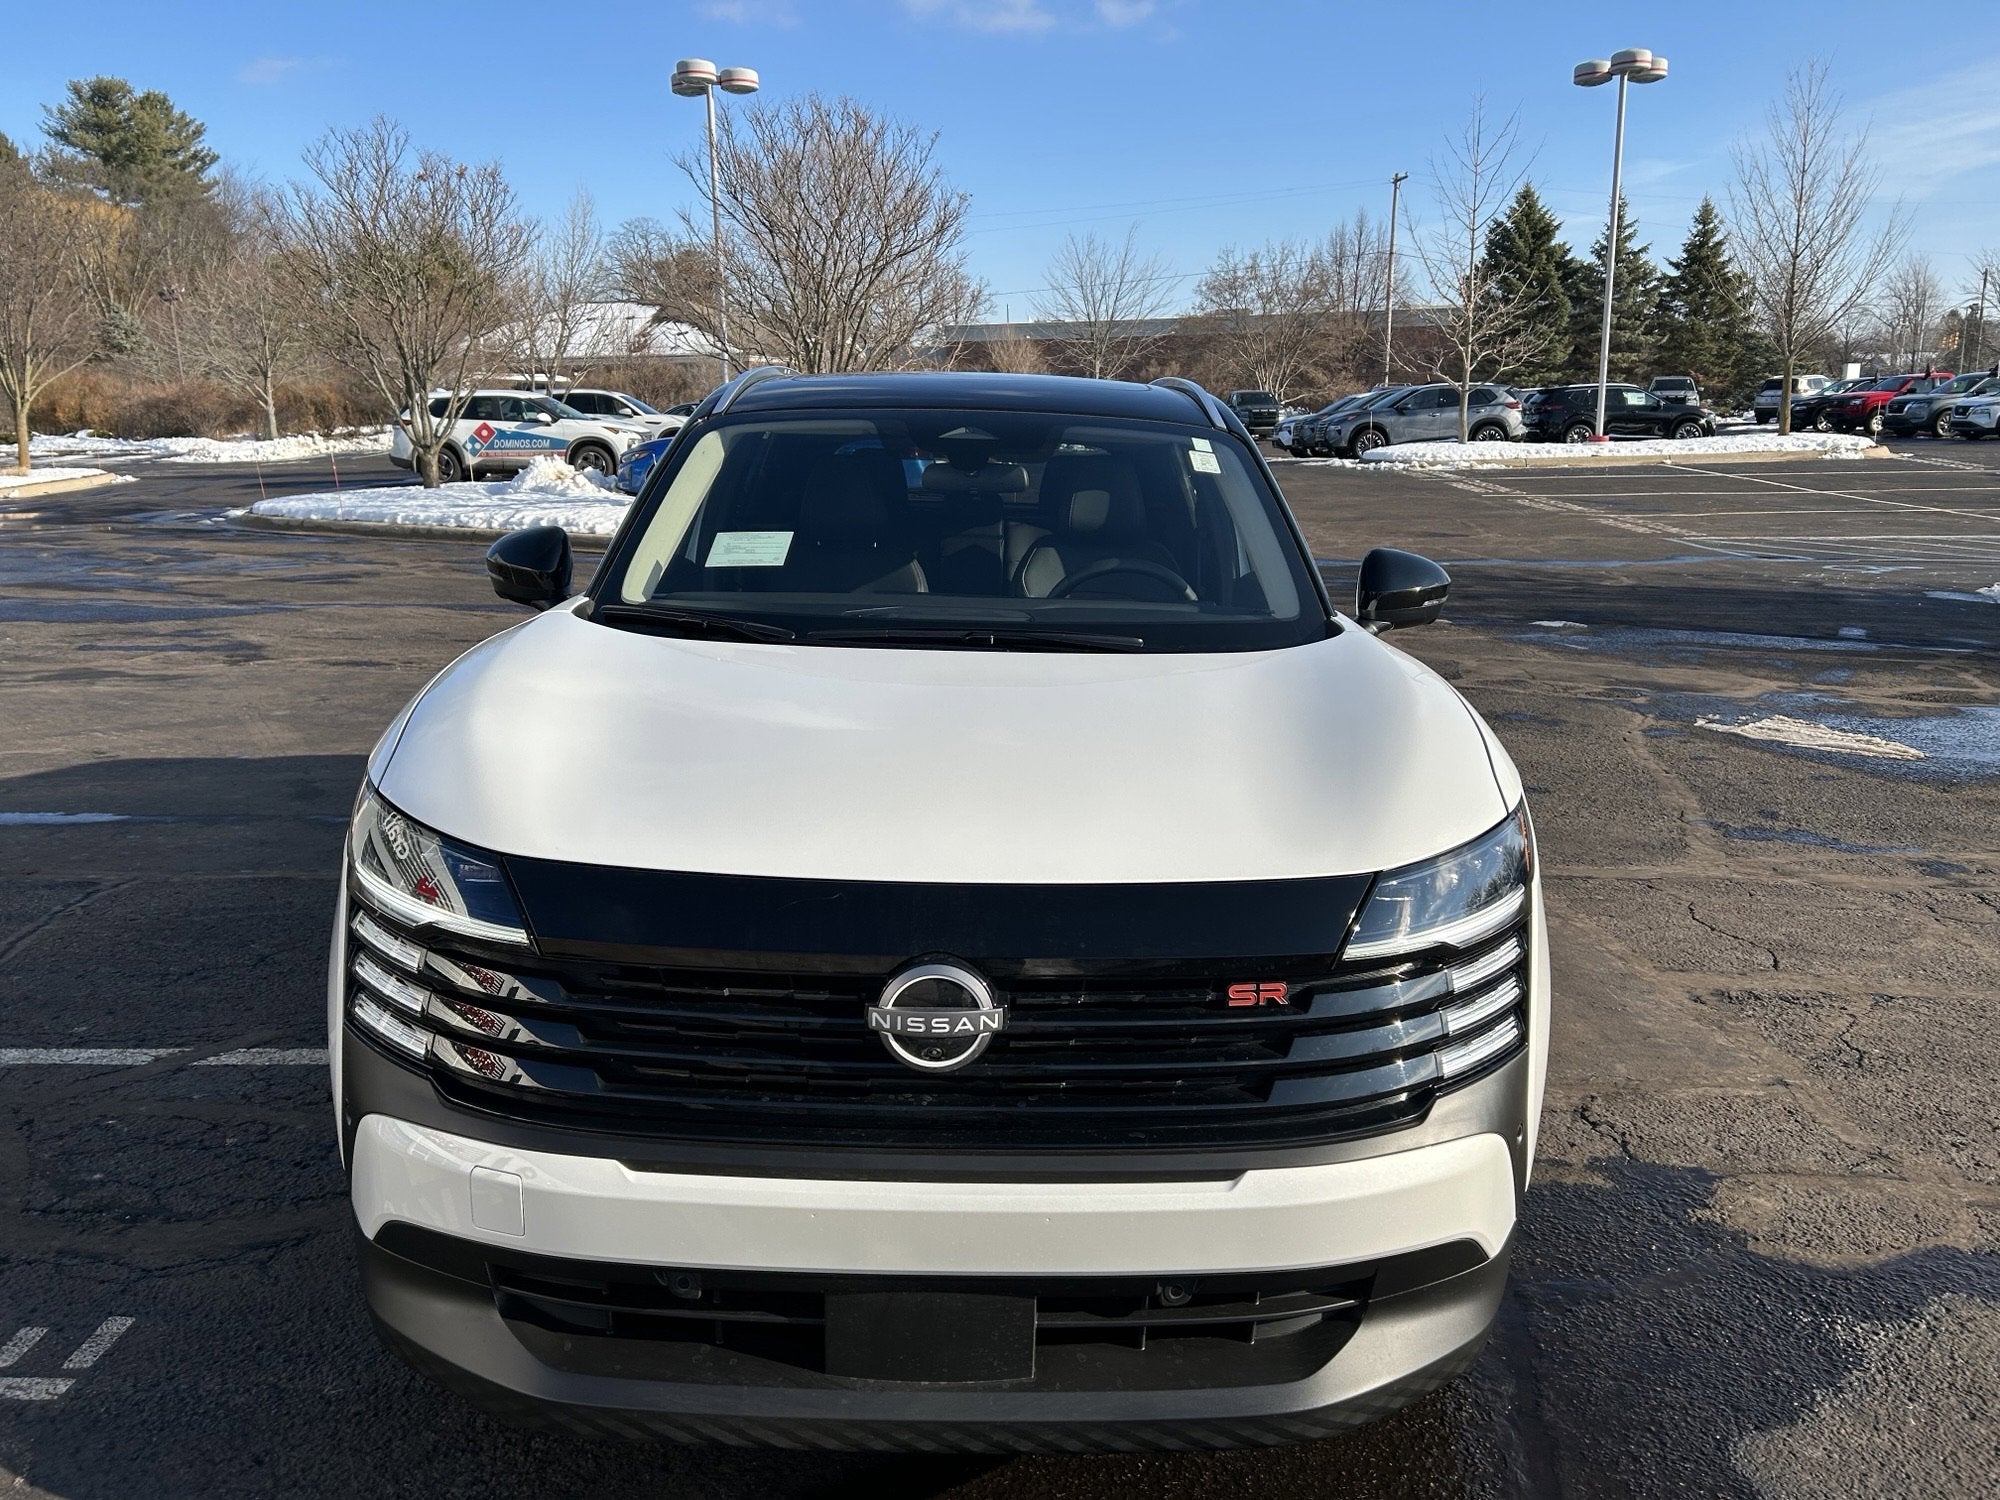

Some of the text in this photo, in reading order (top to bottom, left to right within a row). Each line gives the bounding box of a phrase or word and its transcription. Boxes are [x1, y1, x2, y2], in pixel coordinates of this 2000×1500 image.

[493, 439, 550, 449] DOMINOS.COM
[1228, 982, 1289, 1007] SR
[871, 1011, 999, 1033] NISSAN
